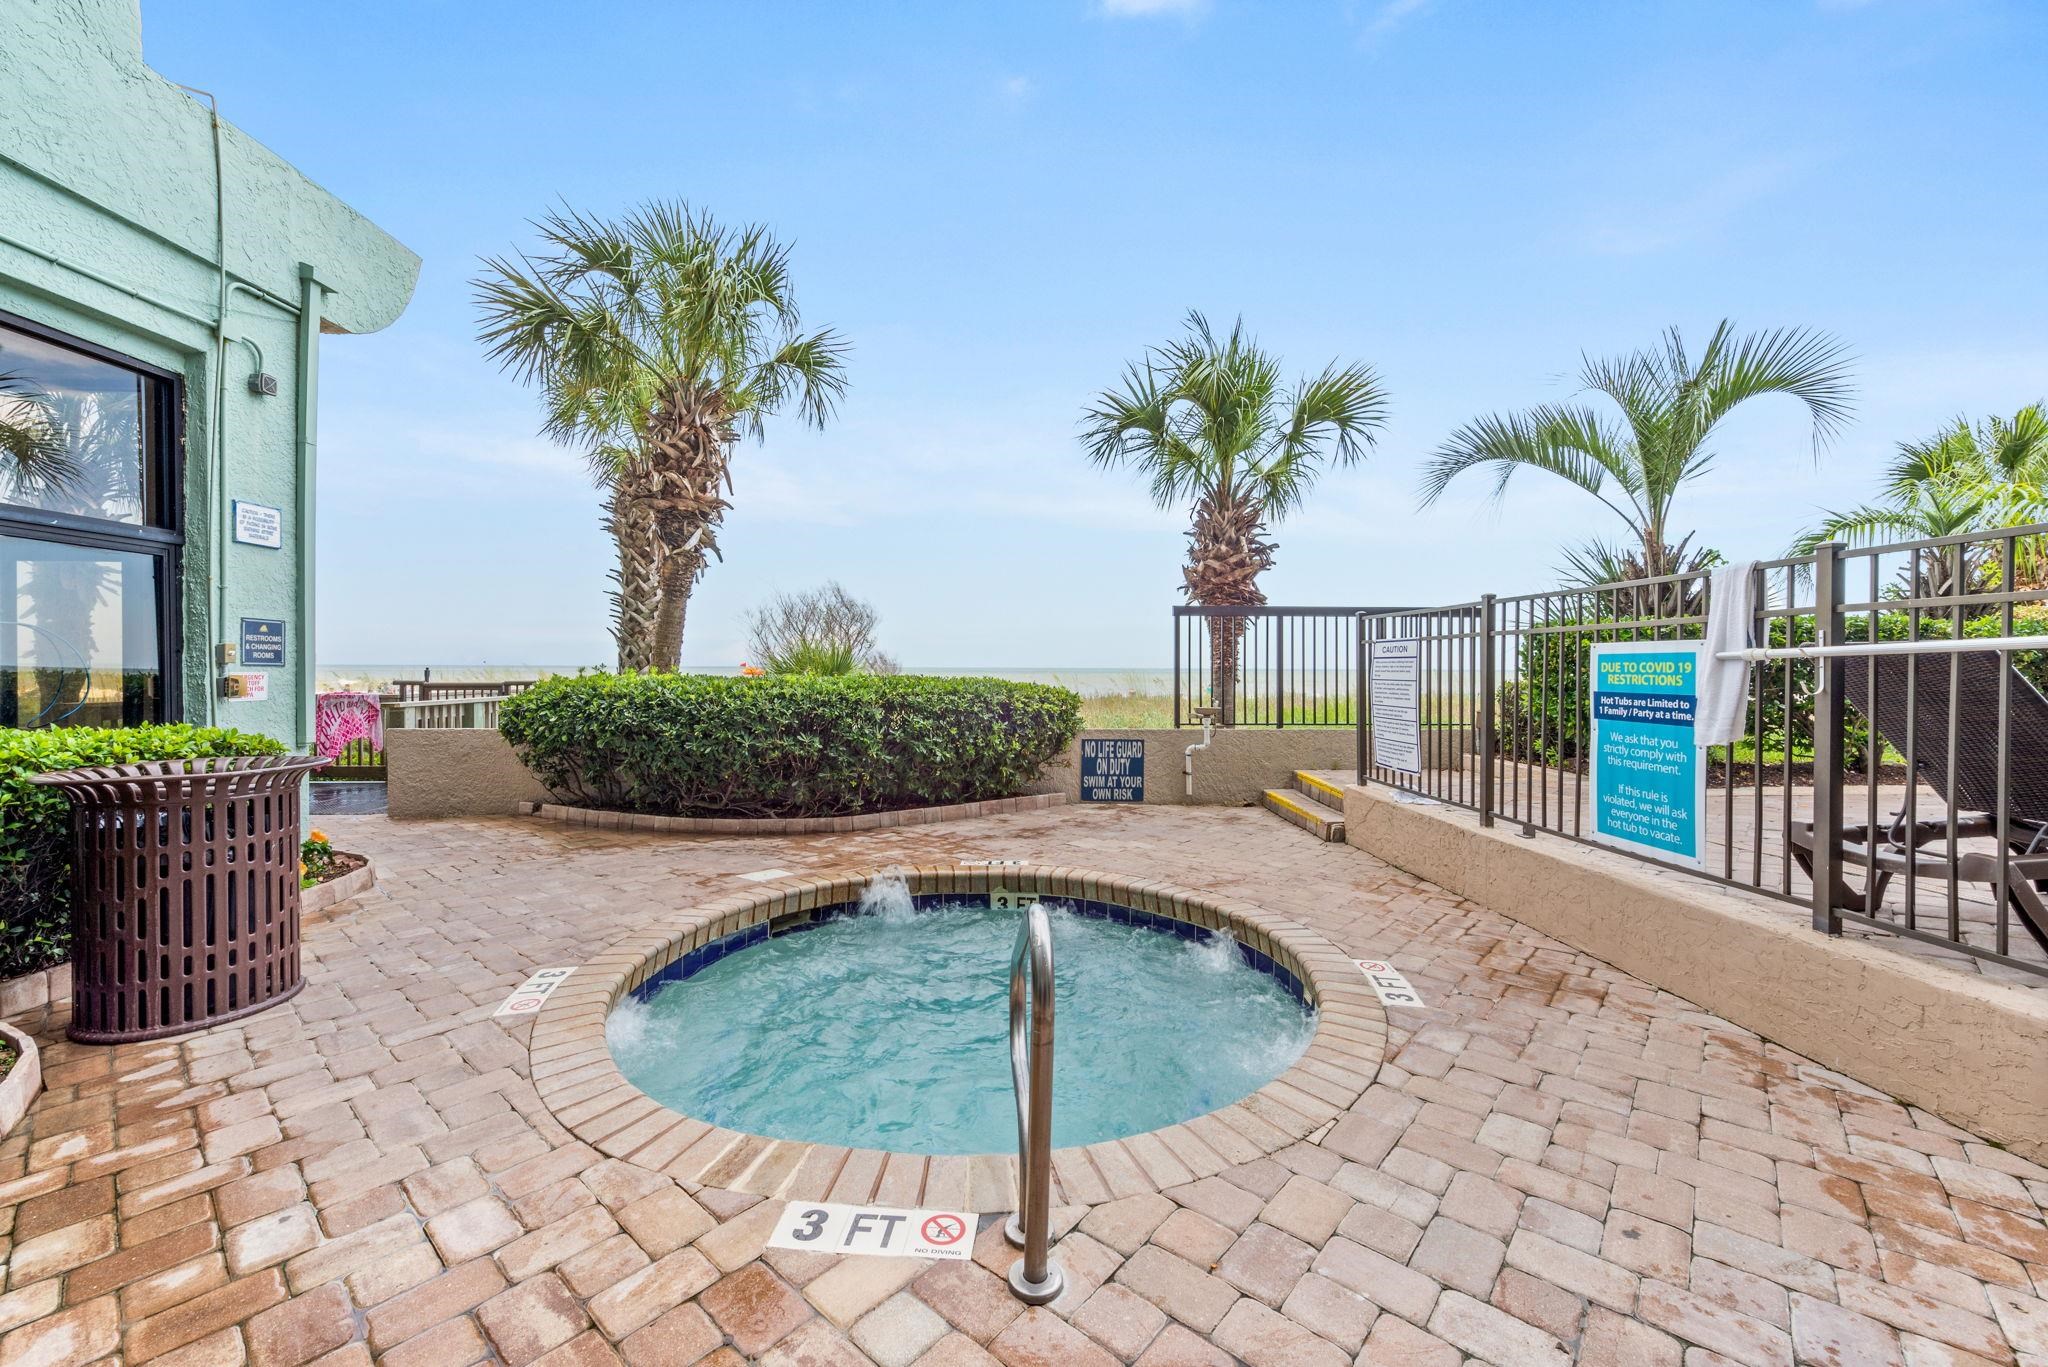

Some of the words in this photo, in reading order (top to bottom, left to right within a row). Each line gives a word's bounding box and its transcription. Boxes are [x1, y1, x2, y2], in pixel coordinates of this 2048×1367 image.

[1382, 645, 1408, 653] CAUTION
[1601, 662, 1621, 673] DUE
[1623, 662, 1637, 673] TO
[1639, 662, 1675, 673] COVID
[1678, 662, 1692, 674] 19
[1607, 674, 1683, 686] RESTRICTIONS
[1601, 696, 1613, 705] Hot
[1615, 697, 1632, 706] Tubs
[1647, 698, 1678, 708] Limited
[1680, 701, 1690, 709] to
[1604, 707, 1628, 718] Family
[1628, 708, 1632, 716] /
[1633, 709, 1654, 720] Party
[1655, 711, 1663, 719] at
[1671, 711, 1694, 720] time.
[1610, 731, 1623, 742] We
[1624, 734, 1639, 744] ask
[1640, 735, 1658, 746] that
[1660, 740, 1678, 750] you
[1085, 741, 1096, 758] NO
[1098, 741, 1115, 758] LIFE
[1116, 741, 1142, 758] GUARD
[1603, 744, 1629, 757] strictly
[1630, 748, 1664, 761] comply
[1665, 752, 1687, 763] with
[1096, 758, 1108, 775] ON
[1110, 758, 1131, 775] DUTY
[1607, 755, 1621, 766] this
[1623, 759, 1681, 776] requirement.
[1083, 776, 1105, 787] SWIM
[1107, 776, 1118, 788] AT
[1119, 776, 1142, 788] YOUR
[1092, 789, 1111, 800] OWN
[1113, 789, 1133, 800] RISK
[1618, 784, 1625, 794] If
[1625, 786, 1640, 797] this
[1642, 790, 1659, 801] rule
[1661, 792, 1668, 803] is
[1603, 793, 1638, 810] violated,
[1639, 803, 1653, 812] we
[1654, 804, 1670, 816] will
[1671, 808, 1688, 819] ask
[1611, 808, 1650, 823] everyone
[1651, 815, 1660, 825] in
[1662, 819, 1678, 830] the
[1607, 817, 1621, 828] hot
[1622, 821, 1638, 833] tub
[1639, 825, 1649, 835] to
[1650, 830, 1683, 845] vacate.
[997, 897, 1008, 909] 3
[516, 981, 556, 995] FT
[1371, 975, 1407, 989] FT
[1385, 993, 1414, 1002] 3
[792, 1209, 829, 1241] 3
[843, 1213, 907, 1249] FT
